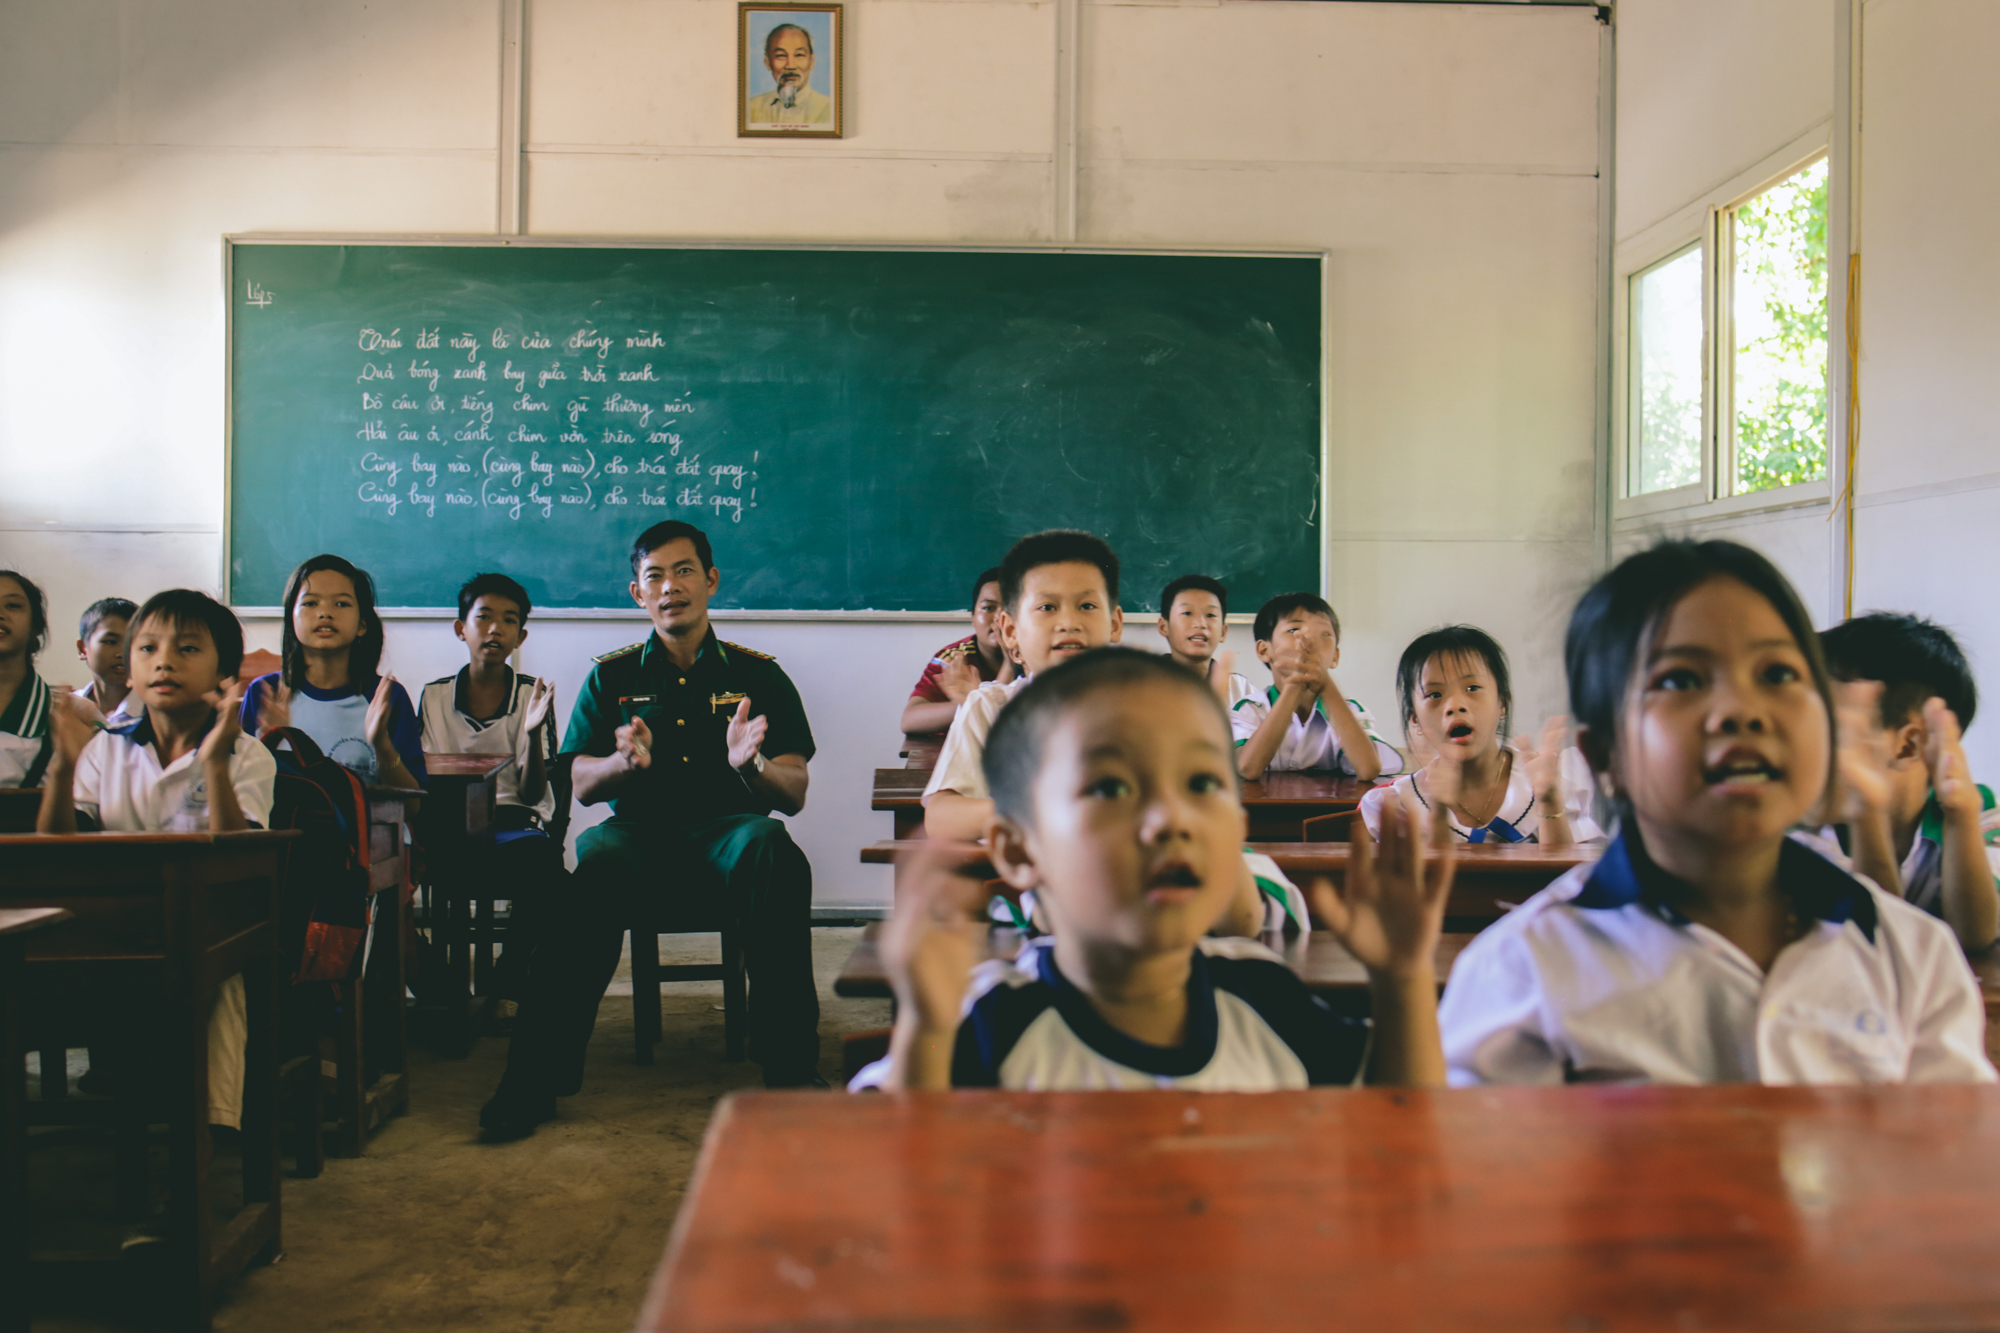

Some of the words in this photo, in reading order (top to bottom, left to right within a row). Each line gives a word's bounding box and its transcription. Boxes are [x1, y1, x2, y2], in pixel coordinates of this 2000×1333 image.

[416, 327, 440, 349] đất
[450, 332, 481, 363] này
[492, 327, 510, 349] là
[520, 331, 552, 349] của
[569, 329, 614, 358] chúng
[626, 330, 666, 348] mình
[357, 362, 395, 384] Quả
[408, 360, 441, 392] bóng
[453, 360, 488, 381] xanh
[503, 360, 526, 392] bay
[579, 364, 607, 382] trời
[617, 363, 660, 382] xanh
[362, 392, 384, 410] Bồ
[392, 393, 420, 410] câu
[460, 390, 494, 424] tiếng
[513, 393, 550, 411] chim
[664, 391, 696, 413] mến
[356, 420, 387, 441] Hải
[398, 423, 420, 441] âu
[454, 420, 494, 442] cánh
[508, 424, 548, 442] chim
[602, 427, 636, 443] trên
[645, 420, 684, 456] sóng
[360, 452, 403, 487] Cùng
[412, 452, 438, 487] bay
[530, 451, 555, 486] bay
[604, 455, 629, 474] cho
[635, 455, 667, 474] trái
[675, 454, 700, 475] đất
[358, 482, 403, 516] Cùng
[407, 482, 436, 518] bay
[527, 482, 554, 518] bay
[604, 486, 628, 505] cho
[637, 485, 668, 506] trái
[676, 484, 703, 505] đất
